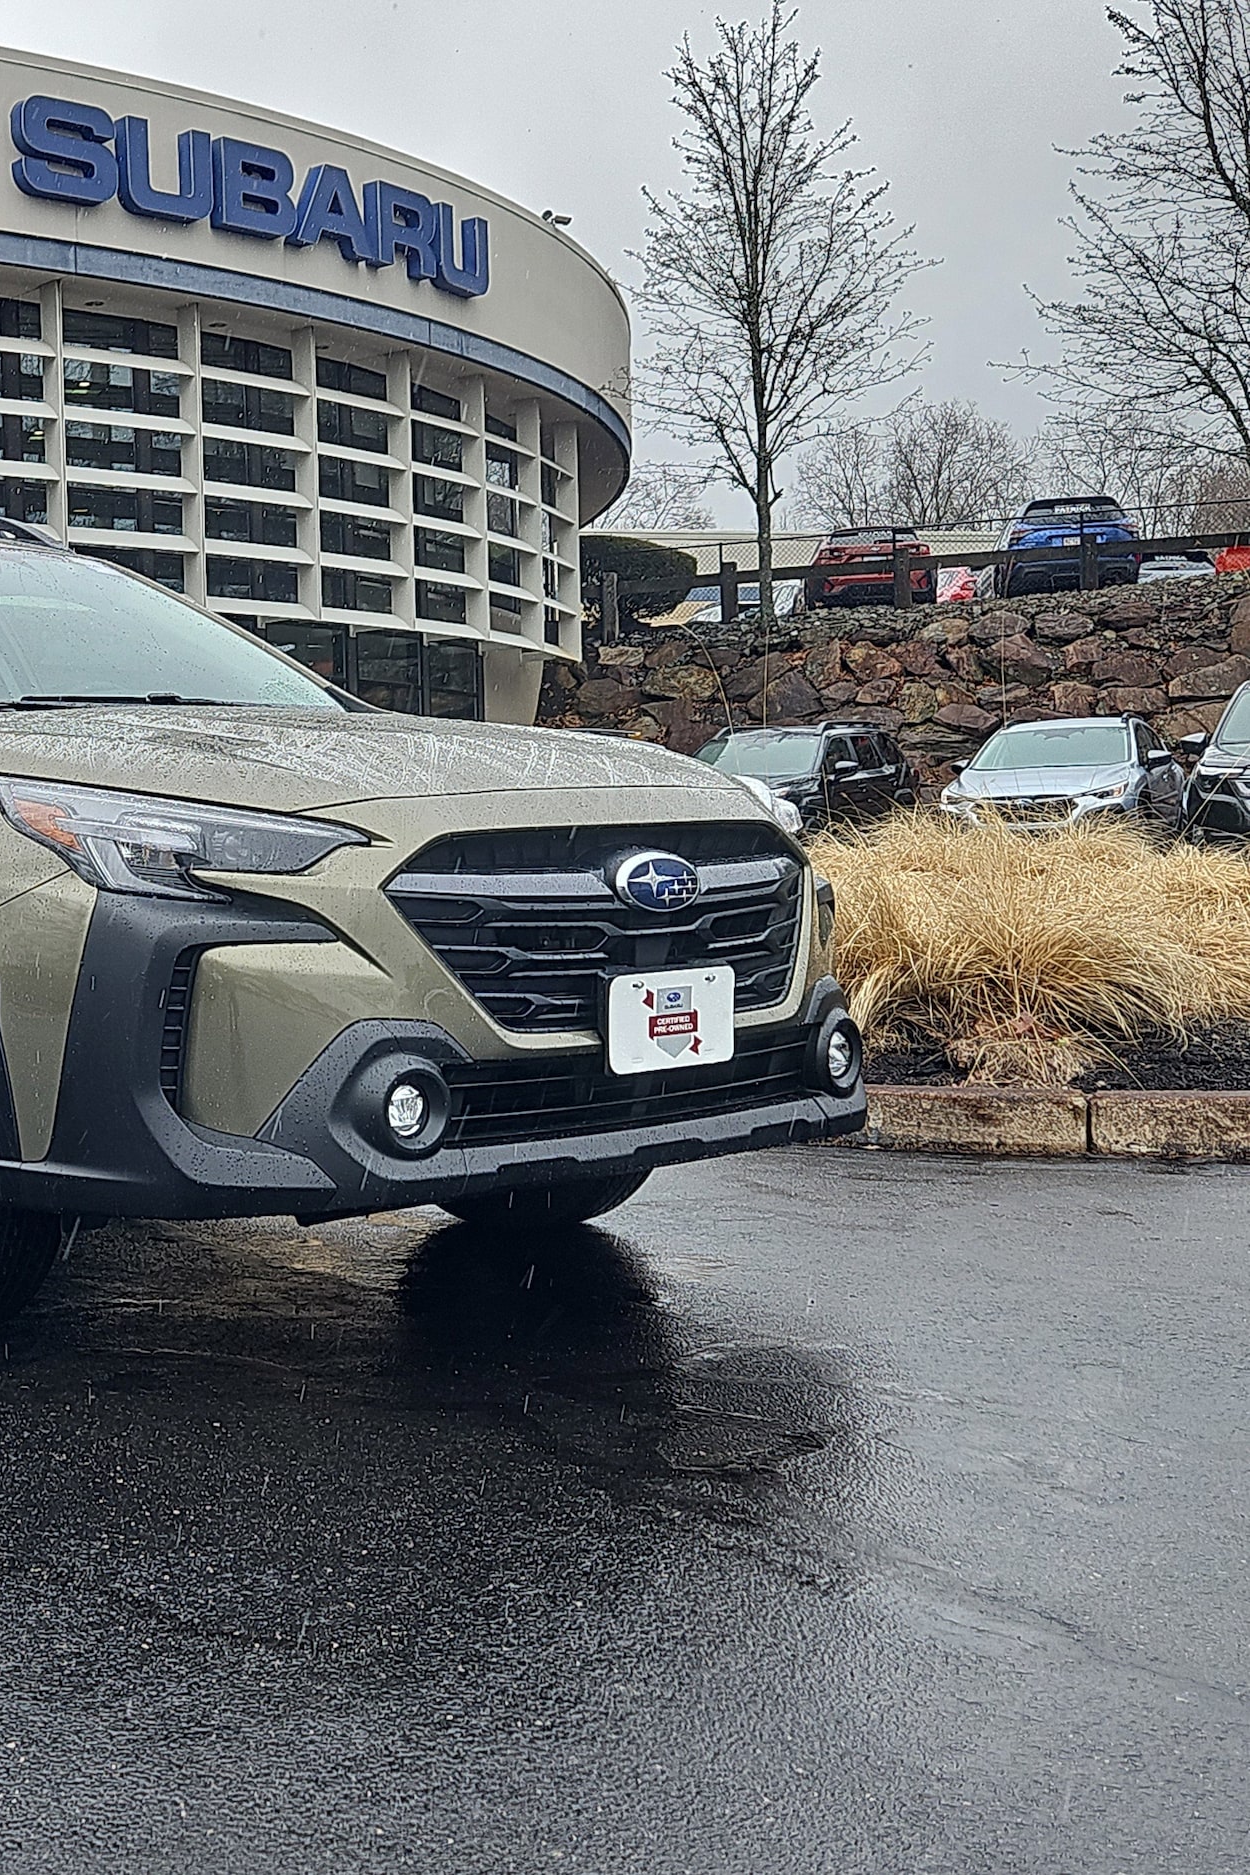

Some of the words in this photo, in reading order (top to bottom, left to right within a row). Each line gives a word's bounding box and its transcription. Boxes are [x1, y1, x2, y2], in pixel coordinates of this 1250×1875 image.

[10, 94, 491, 299] SUBARU
[1054, 503, 1091, 514] PATRICK
[656, 1015, 690, 1025] CERTIFIED
[653, 1023, 693, 1034] PRE-OWNED
